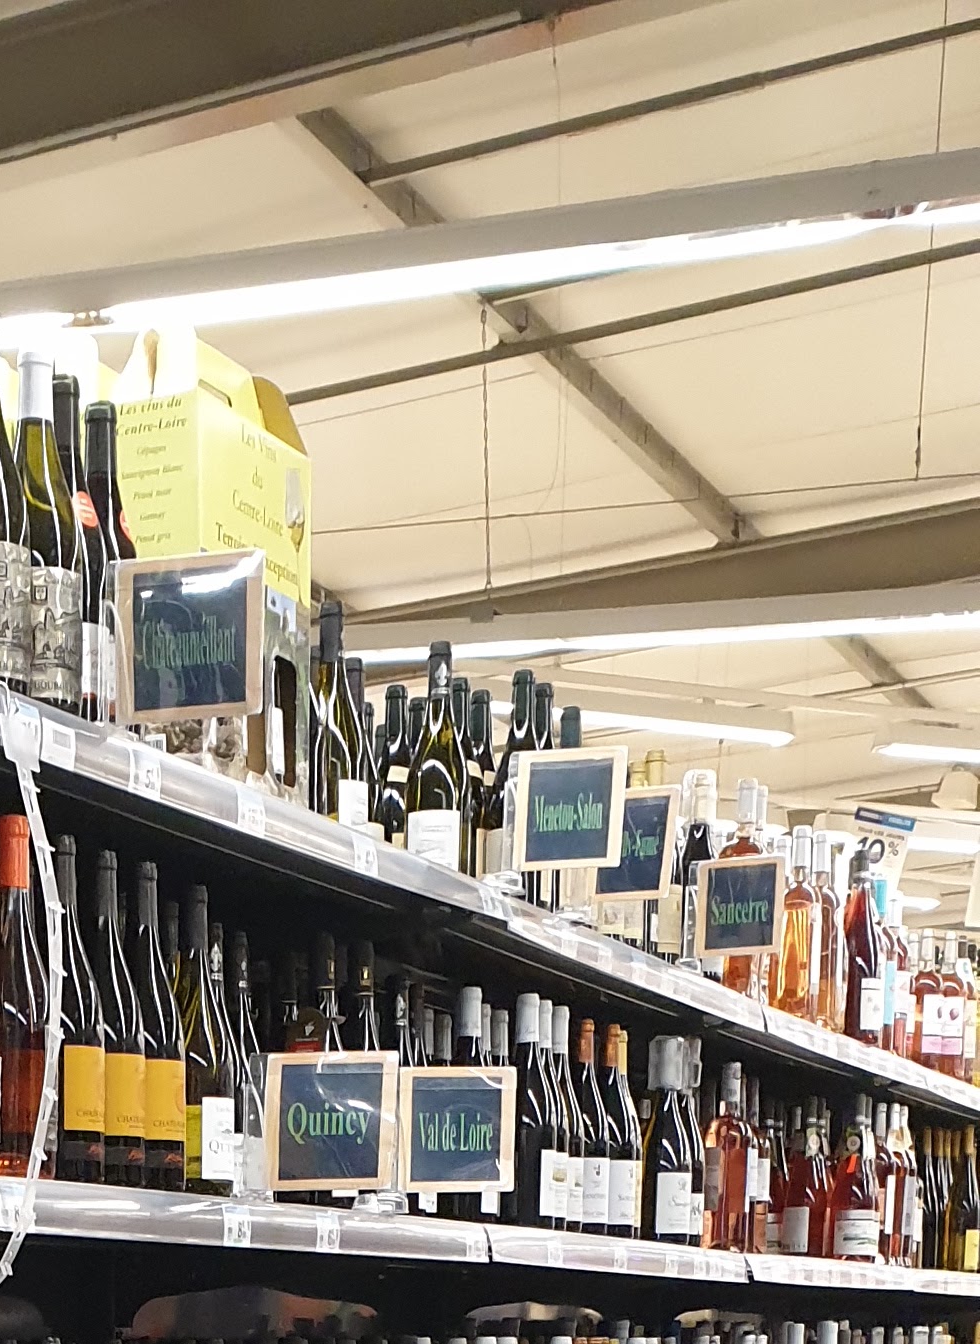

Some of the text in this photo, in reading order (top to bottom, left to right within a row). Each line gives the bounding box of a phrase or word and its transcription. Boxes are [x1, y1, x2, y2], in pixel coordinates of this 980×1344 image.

[710, 896, 769, 927] Sancerre
[286, 1101, 371, 1145] Quincy
[418, 1112, 494, 1151] Val de Loire
